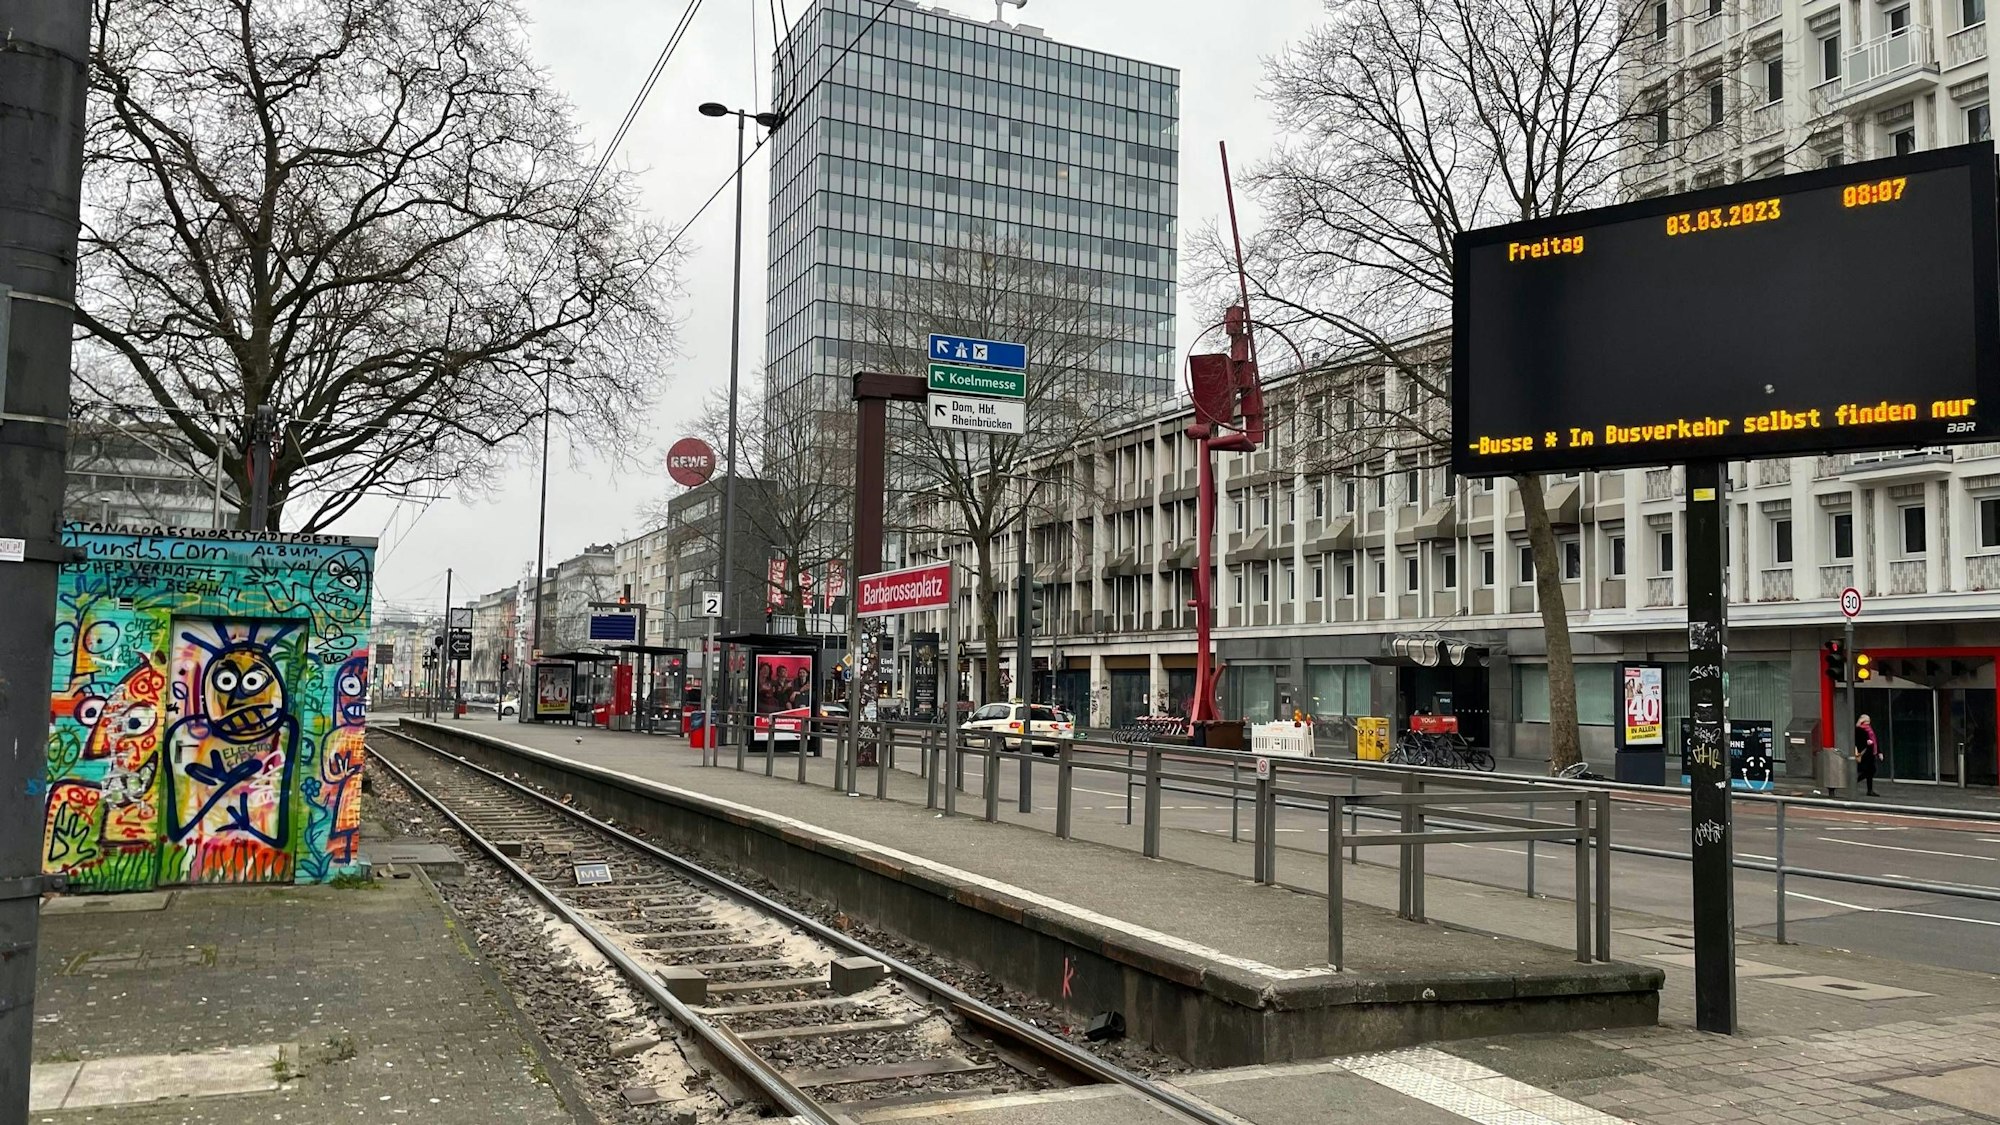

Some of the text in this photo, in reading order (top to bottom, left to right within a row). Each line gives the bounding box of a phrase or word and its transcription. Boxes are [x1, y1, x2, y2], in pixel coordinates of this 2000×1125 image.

[1843, 177, 1907, 208] 08:07
[1666, 198, 1781, 236] 03.03.2023
[1508, 235, 1584, 262] Freitag
[949, 372, 1016, 390] Koelnmesse
[952, 400, 996, 415] Dom, Hbf.
[952, 414, 1012, 429] Rheinbrücken
[1605, 416, 1730, 445] Busverkehr
[1743, 409, 1821, 434] selbst
[1834, 401, 1917, 426] finden
[1931, 398, 1977, 419] nur
[1946, 421, 1977, 434] BBR
[670, 455, 709, 468] REWE
[863, 574, 943, 606] Barbarossaplatz
[706, 599, 718, 614] 2
[1845, 595, 1857, 609] 30
[543, 683, 568, 700] 40
[1628, 695, 1658, 721] 40
[580, 869, 607, 879] ME
